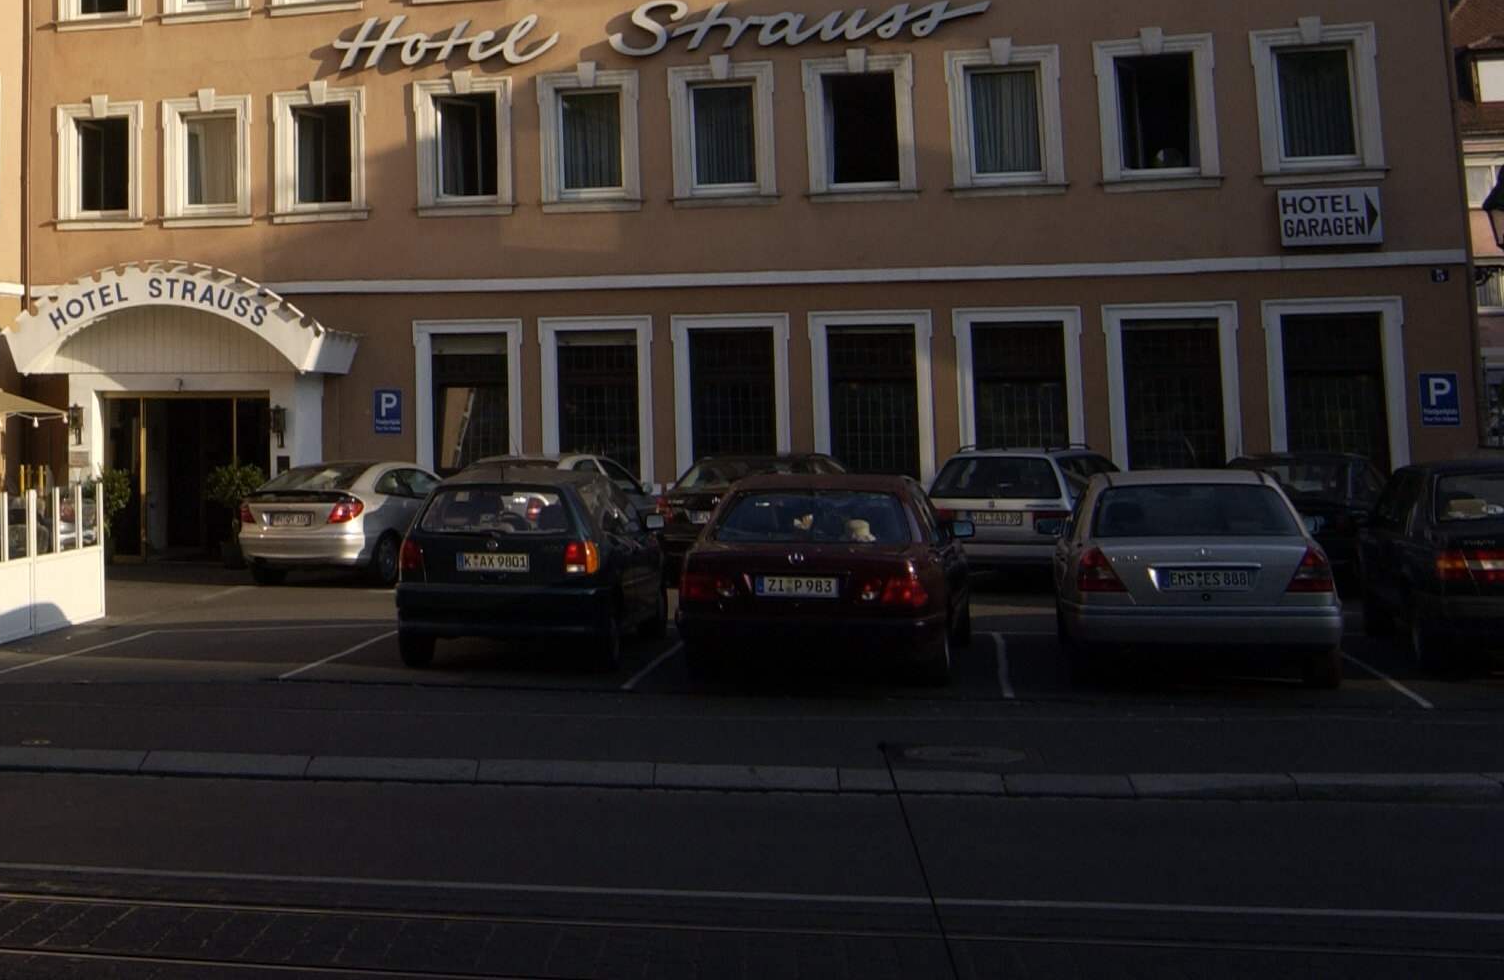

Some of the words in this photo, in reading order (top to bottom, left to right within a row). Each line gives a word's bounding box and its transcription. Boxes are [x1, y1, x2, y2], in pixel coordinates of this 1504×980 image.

[332, 13, 560, 71] Hotel
[608, 0, 993, 58] Strauss
[1281, 194, 1359, 215] HOTEL
[1283, 216, 1366, 238] GARAGEN
[49, 281, 129, 331] HOTEL
[148, 277, 269, 327] STRAUSS
[1428, 377, 1452, 407] P
[380, 392, 398, 418] P
[479, 555, 495, 568] AX
[497, 555, 526, 569] 9801
[806, 579, 833, 593] 983
